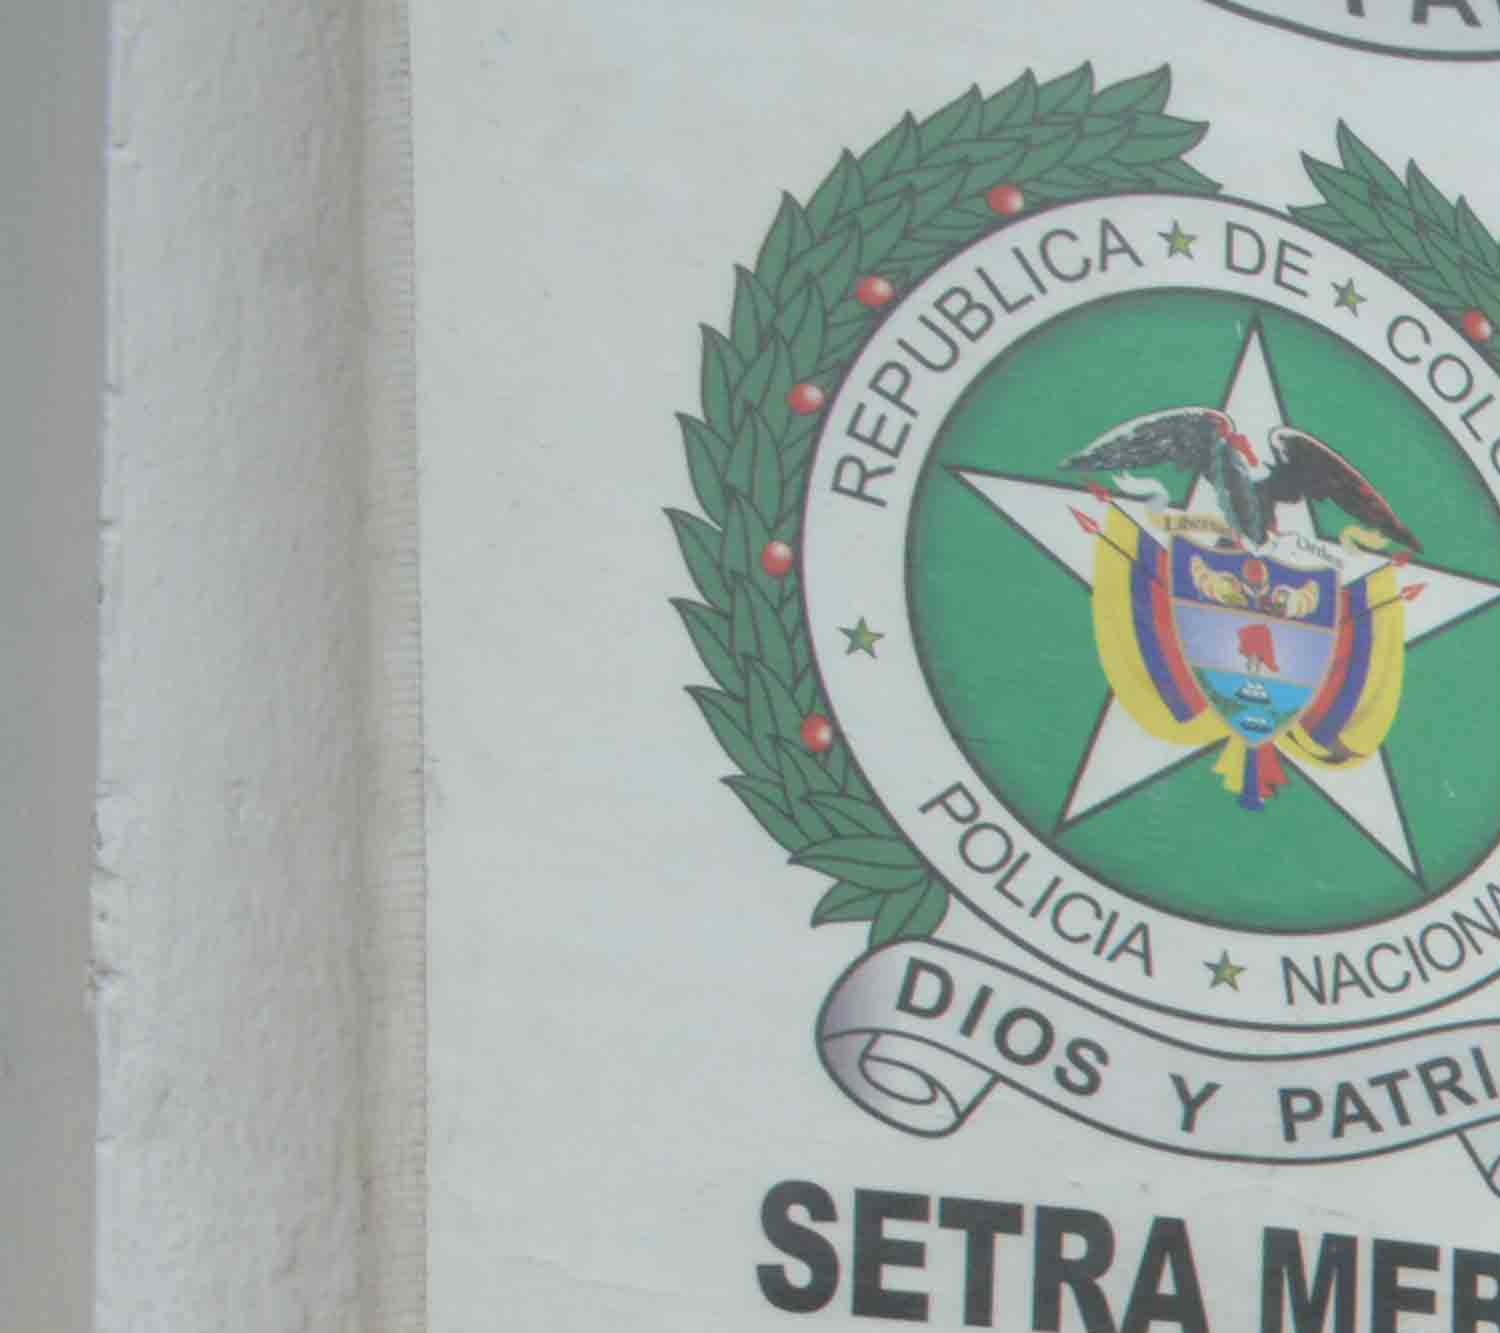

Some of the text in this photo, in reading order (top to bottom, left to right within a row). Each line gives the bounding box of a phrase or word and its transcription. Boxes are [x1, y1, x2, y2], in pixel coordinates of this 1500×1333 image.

[829, 218, 1144, 510] REPUBLICA
[1225, 221, 1315, 292] DE
[916, 780, 1158, 978] POLICIA
[894, 957, 1111, 1097] DIOS
[1170, 1074, 1222, 1137] Y
